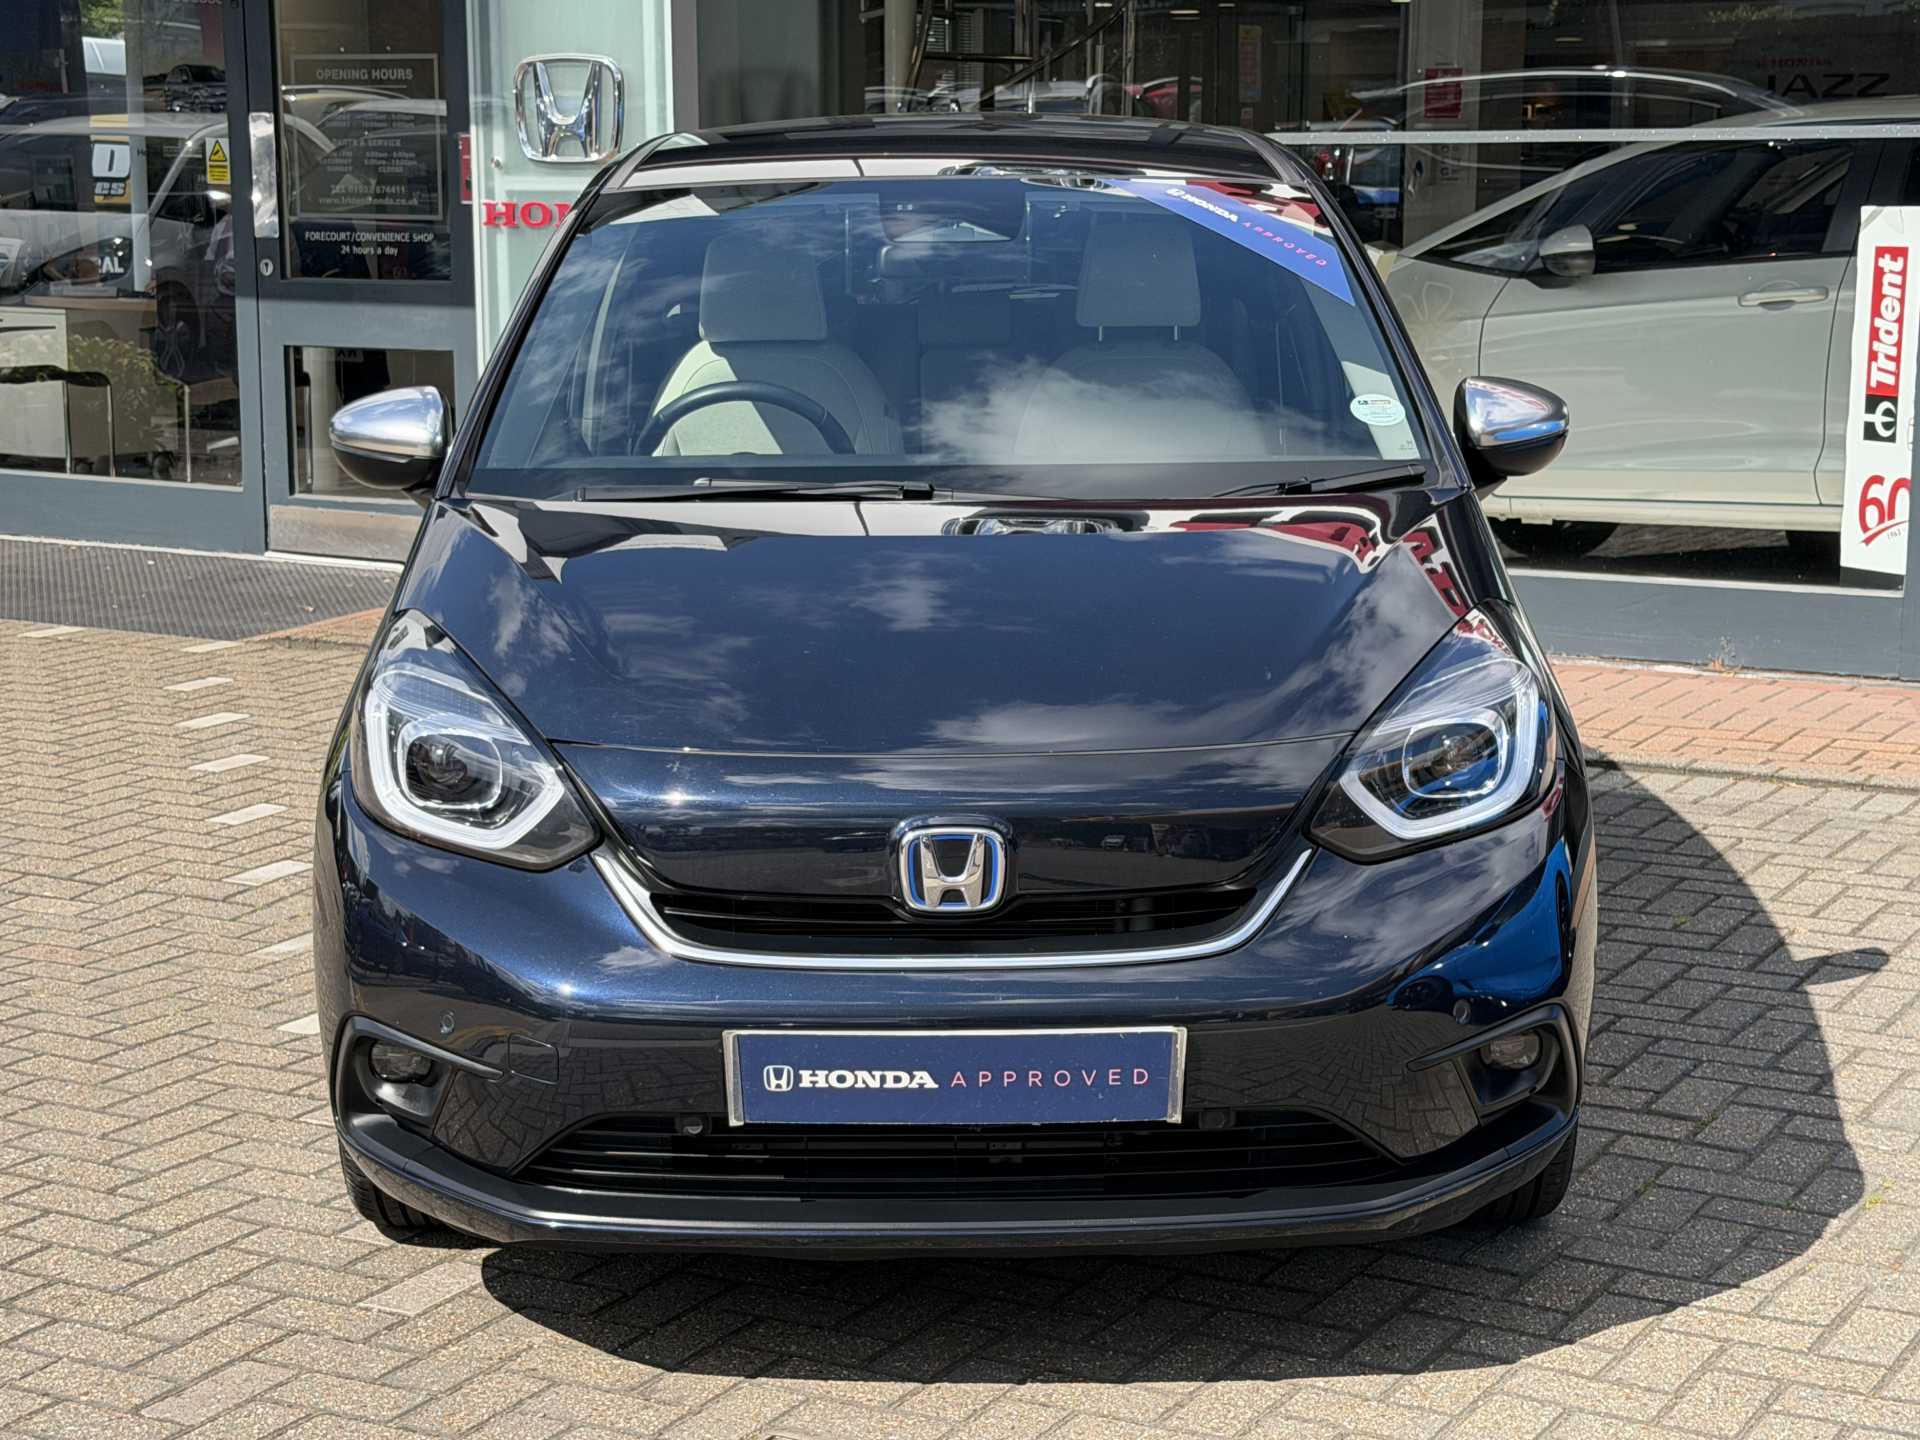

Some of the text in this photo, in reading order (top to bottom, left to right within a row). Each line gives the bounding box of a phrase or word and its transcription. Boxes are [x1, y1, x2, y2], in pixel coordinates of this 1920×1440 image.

[316, 68, 414, 80] OPENING HOURS
[305, 231, 435, 243] FORECOURT/CONVENIENCE SHOP
[1242, 222, 1328, 267] APPROVED
[341, 245, 350, 254] 24
[352, 245, 374, 255] hours
[384, 245, 399, 257] day
[1870, 253, 1904, 388] Trident
[799, 1069, 939, 1089] HONDA
[950, 1068, 1149, 1088] APPROVED
